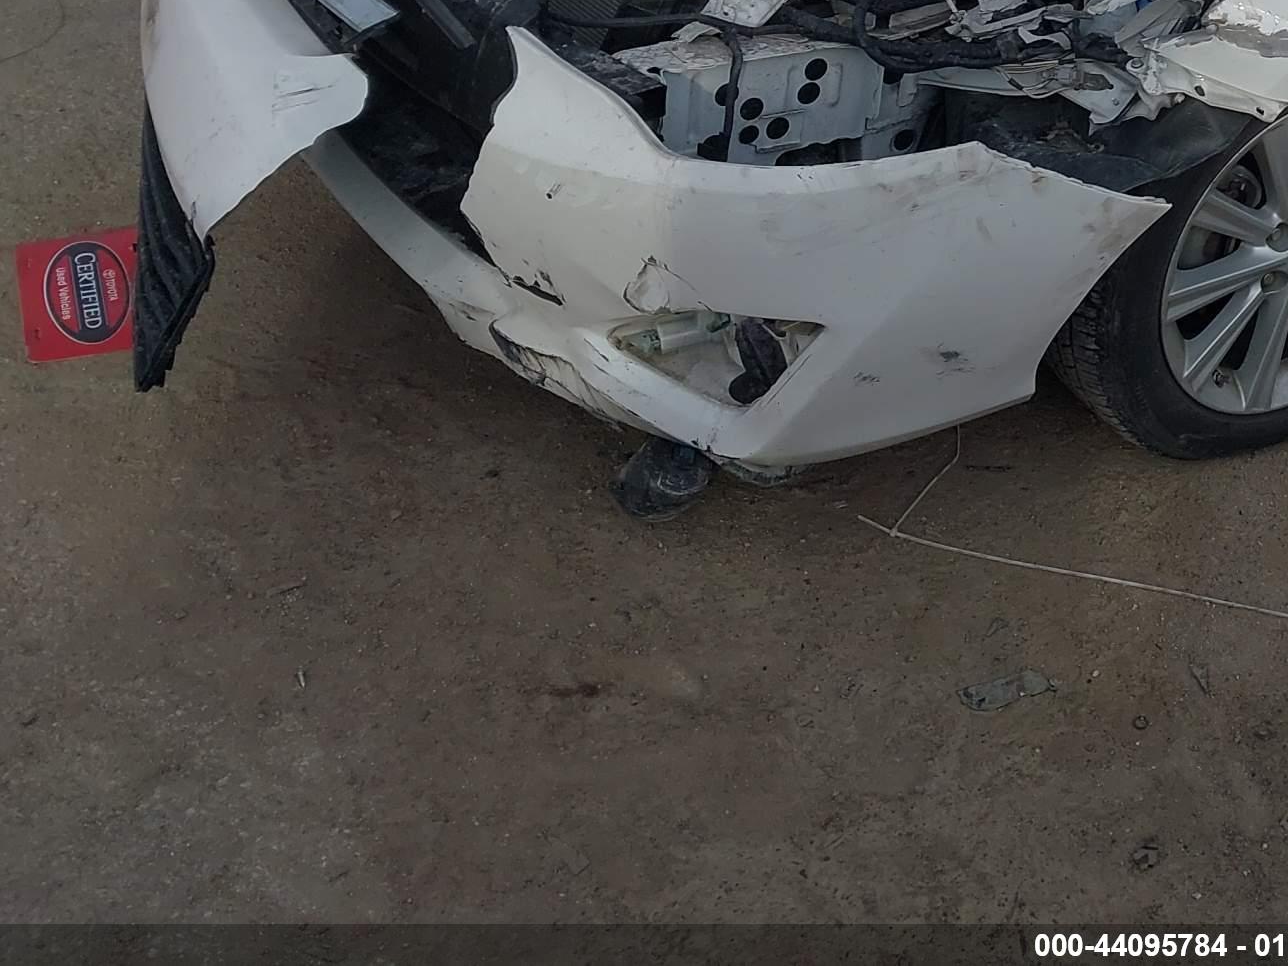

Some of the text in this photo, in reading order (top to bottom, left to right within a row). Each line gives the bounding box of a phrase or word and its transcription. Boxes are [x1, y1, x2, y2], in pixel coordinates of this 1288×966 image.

[56, 267, 72, 321] Used Vehicles
[74, 252, 103, 329] CERTIFIED
